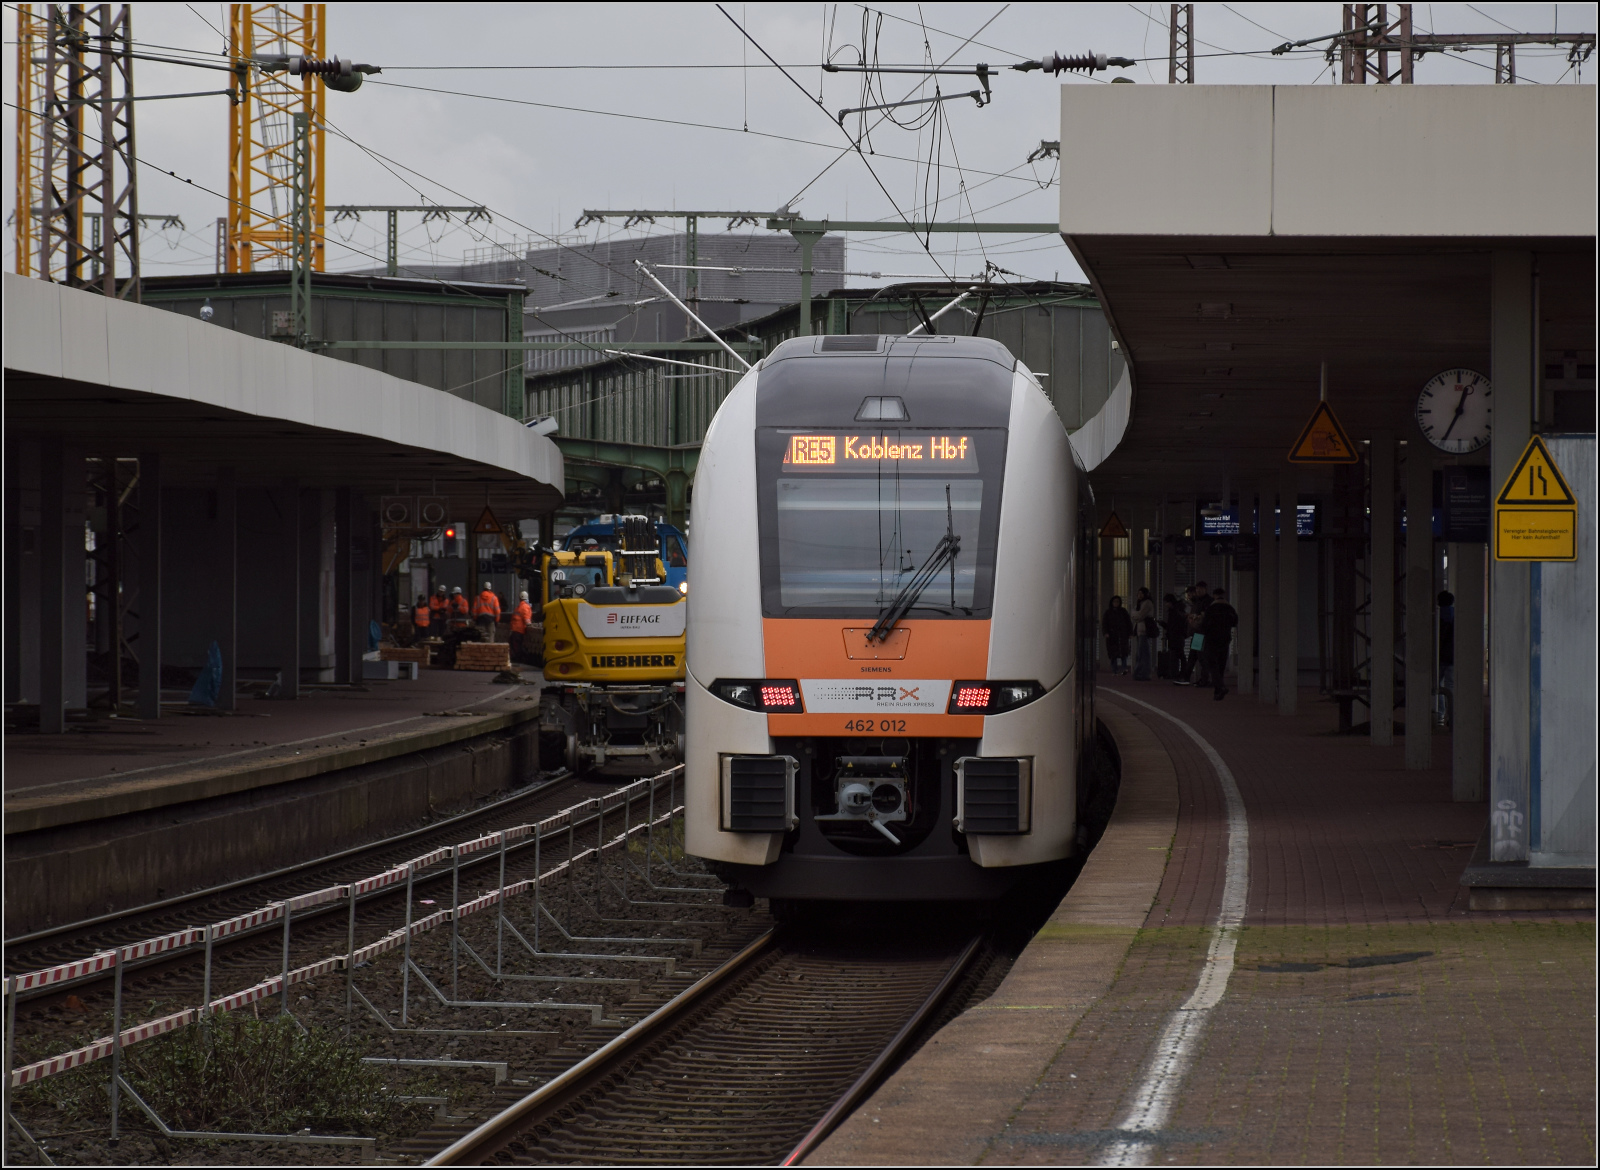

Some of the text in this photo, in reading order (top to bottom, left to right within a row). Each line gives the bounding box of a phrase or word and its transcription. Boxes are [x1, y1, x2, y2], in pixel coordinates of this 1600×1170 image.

[795, 436, 967, 461] RE5 Koblenz Hbf
[553, 571, 563, 582] 20
[620, 615, 660, 624] EIFFAGE
[591, 655, 676, 667] LIEBHERR
[845, 720, 906, 732] 462 012
